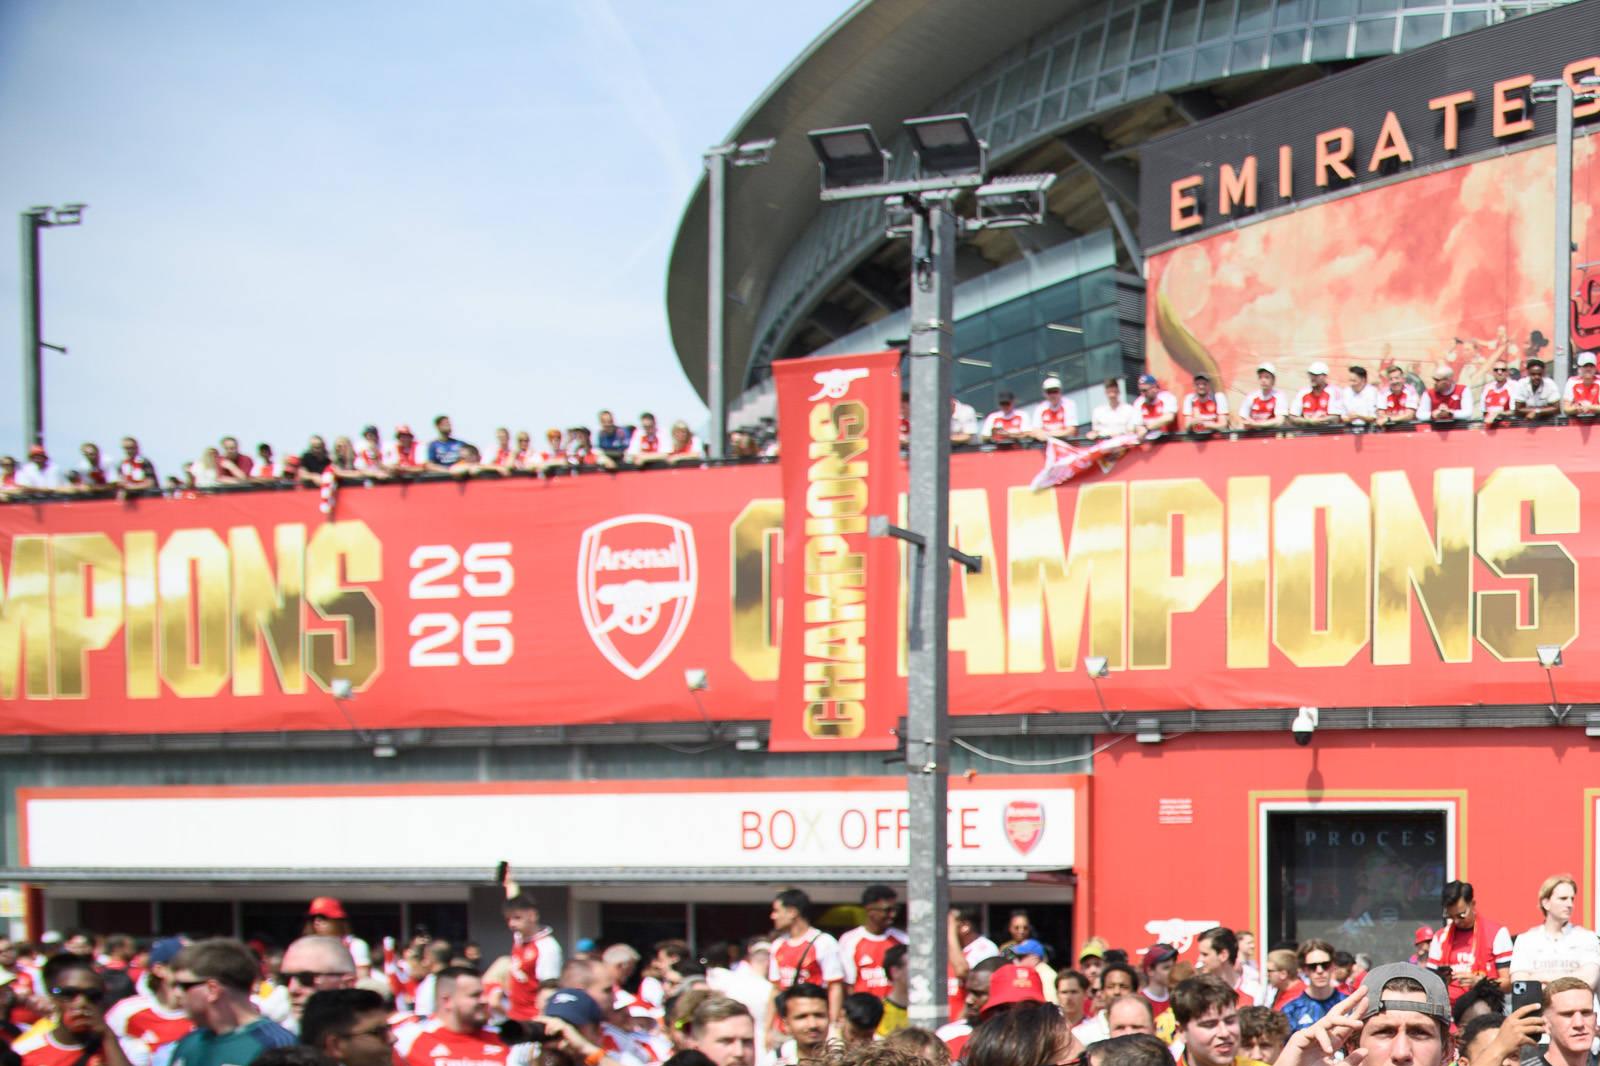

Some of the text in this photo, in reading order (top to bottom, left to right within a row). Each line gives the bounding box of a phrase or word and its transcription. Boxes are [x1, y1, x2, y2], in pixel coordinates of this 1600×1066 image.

[409, 542, 514, 599] 25
[594, 543, 679, 571] Arsenal
[730, 465, 1581, 681] CAMPIONS
[803, 400, 869, 739] CHAMPIONS
[409, 611, 514, 667] 26
[839, 806, 981, 850] OFFE
[1305, 831, 1437, 846] PROCES
